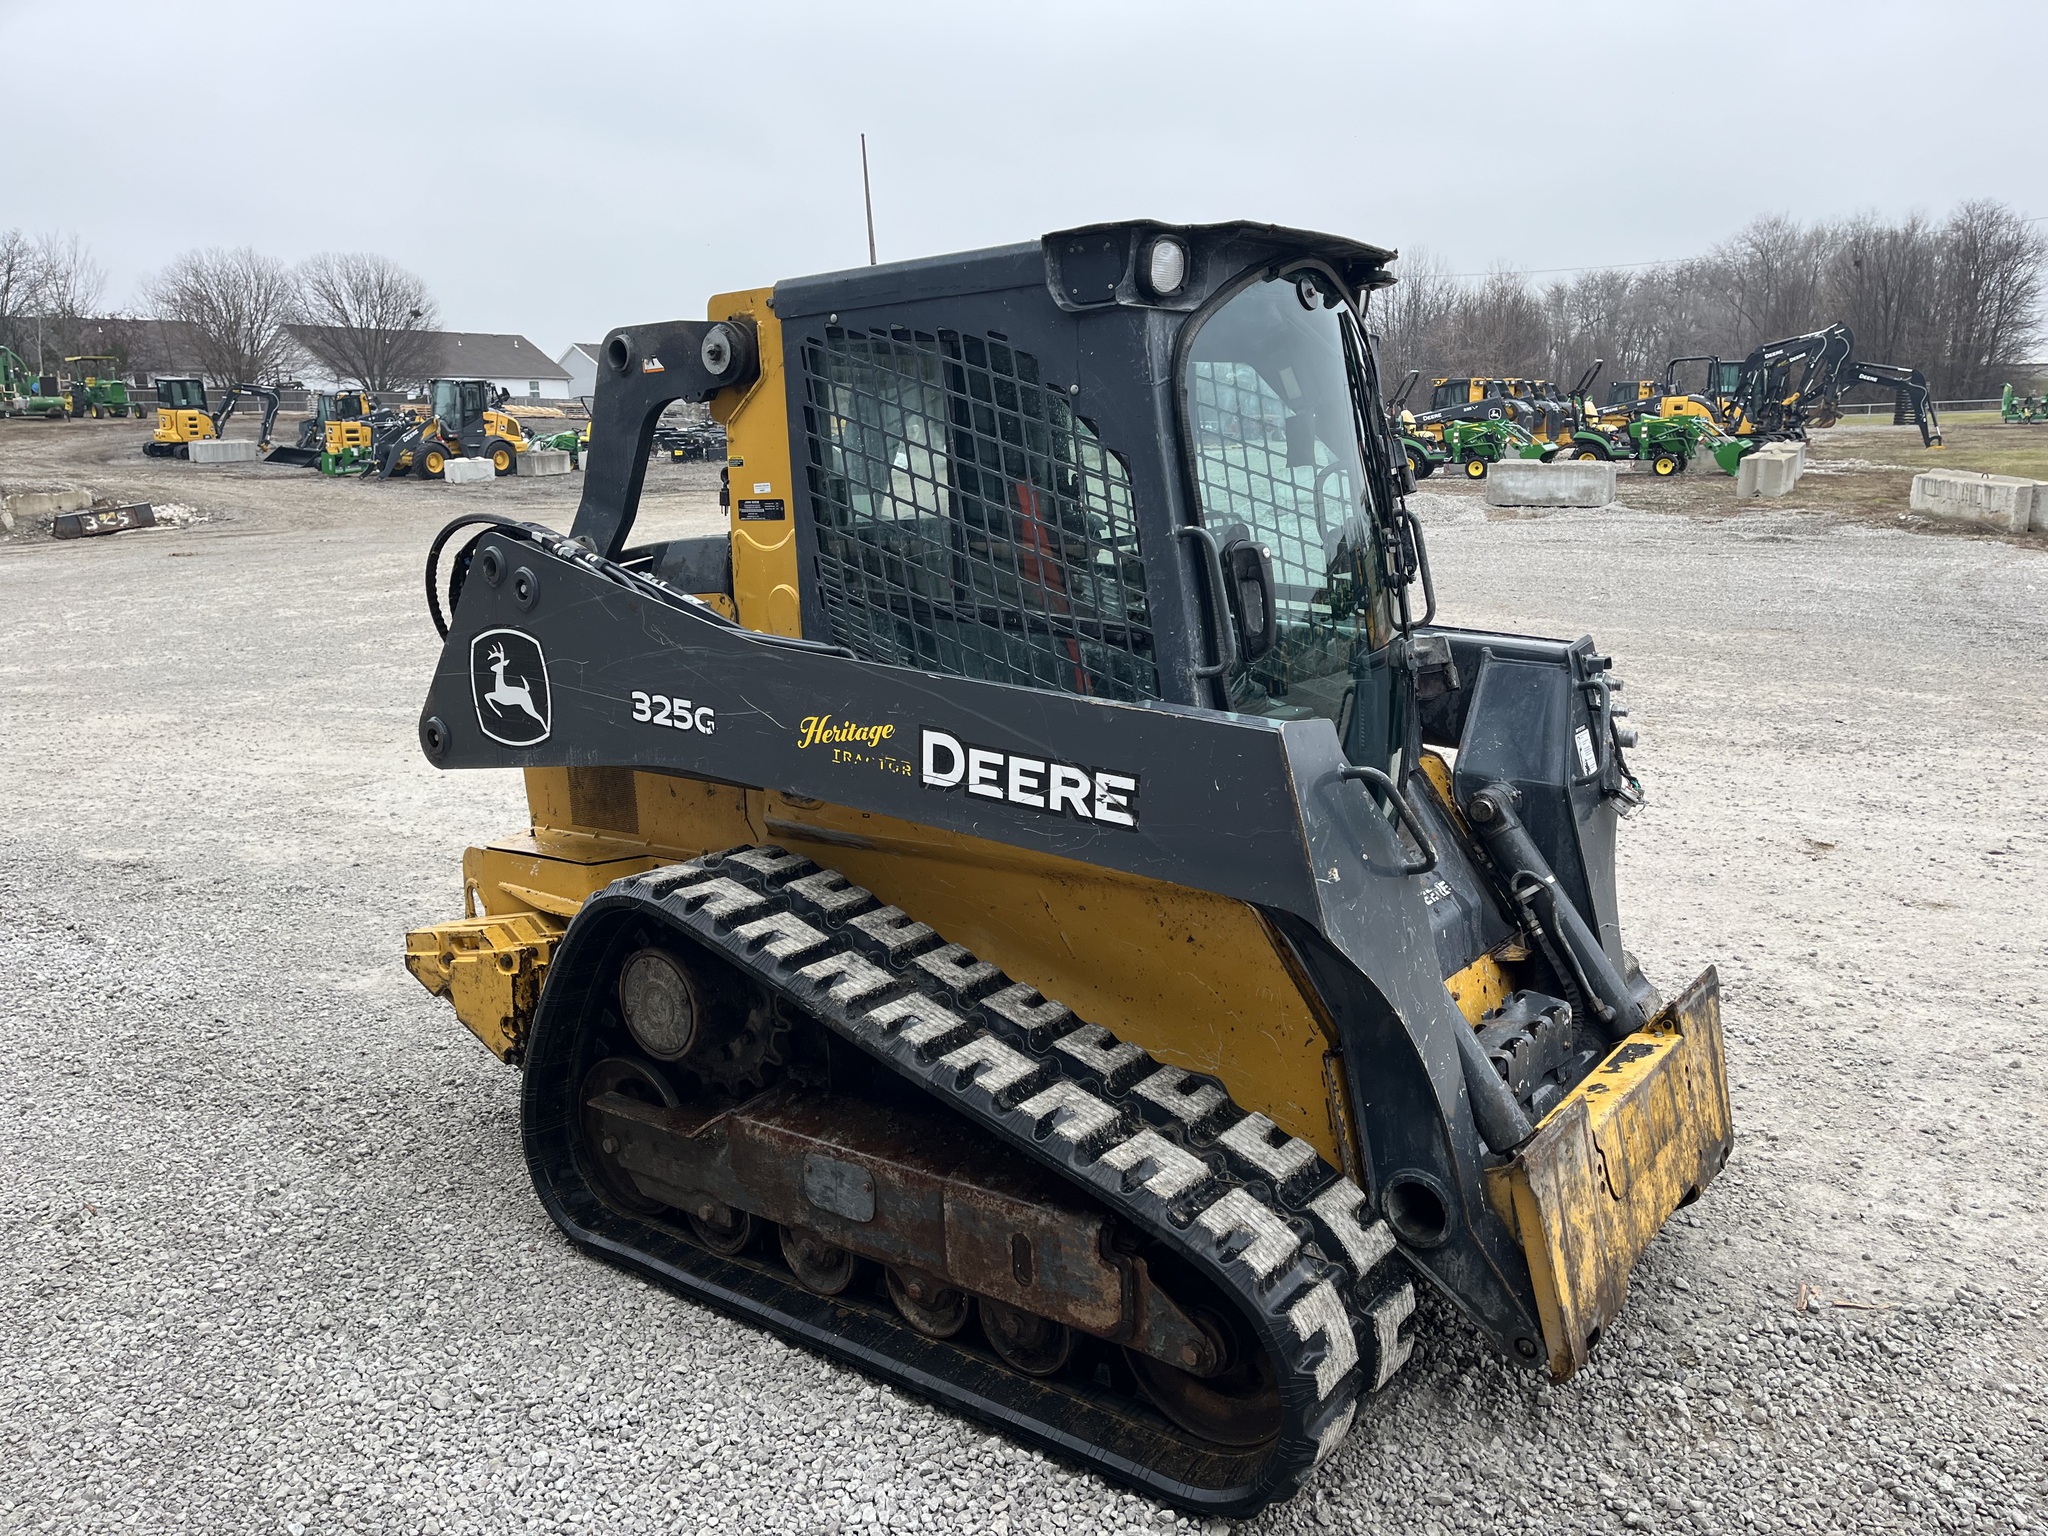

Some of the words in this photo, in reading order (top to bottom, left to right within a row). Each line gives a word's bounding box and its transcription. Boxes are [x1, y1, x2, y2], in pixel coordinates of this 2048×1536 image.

[1764, 349, 1784, 359] DEERE
[1789, 352, 1807, 363] DEERE
[1858, 373, 1879, 383] DEERE
[1422, 412, 1443, 421] DEERE
[402, 428, 420, 443] DEERE
[631, 690, 716, 736] 325G
[797, 714, 897, 749] Heritage
[922, 729, 1137, 827] DEERE
